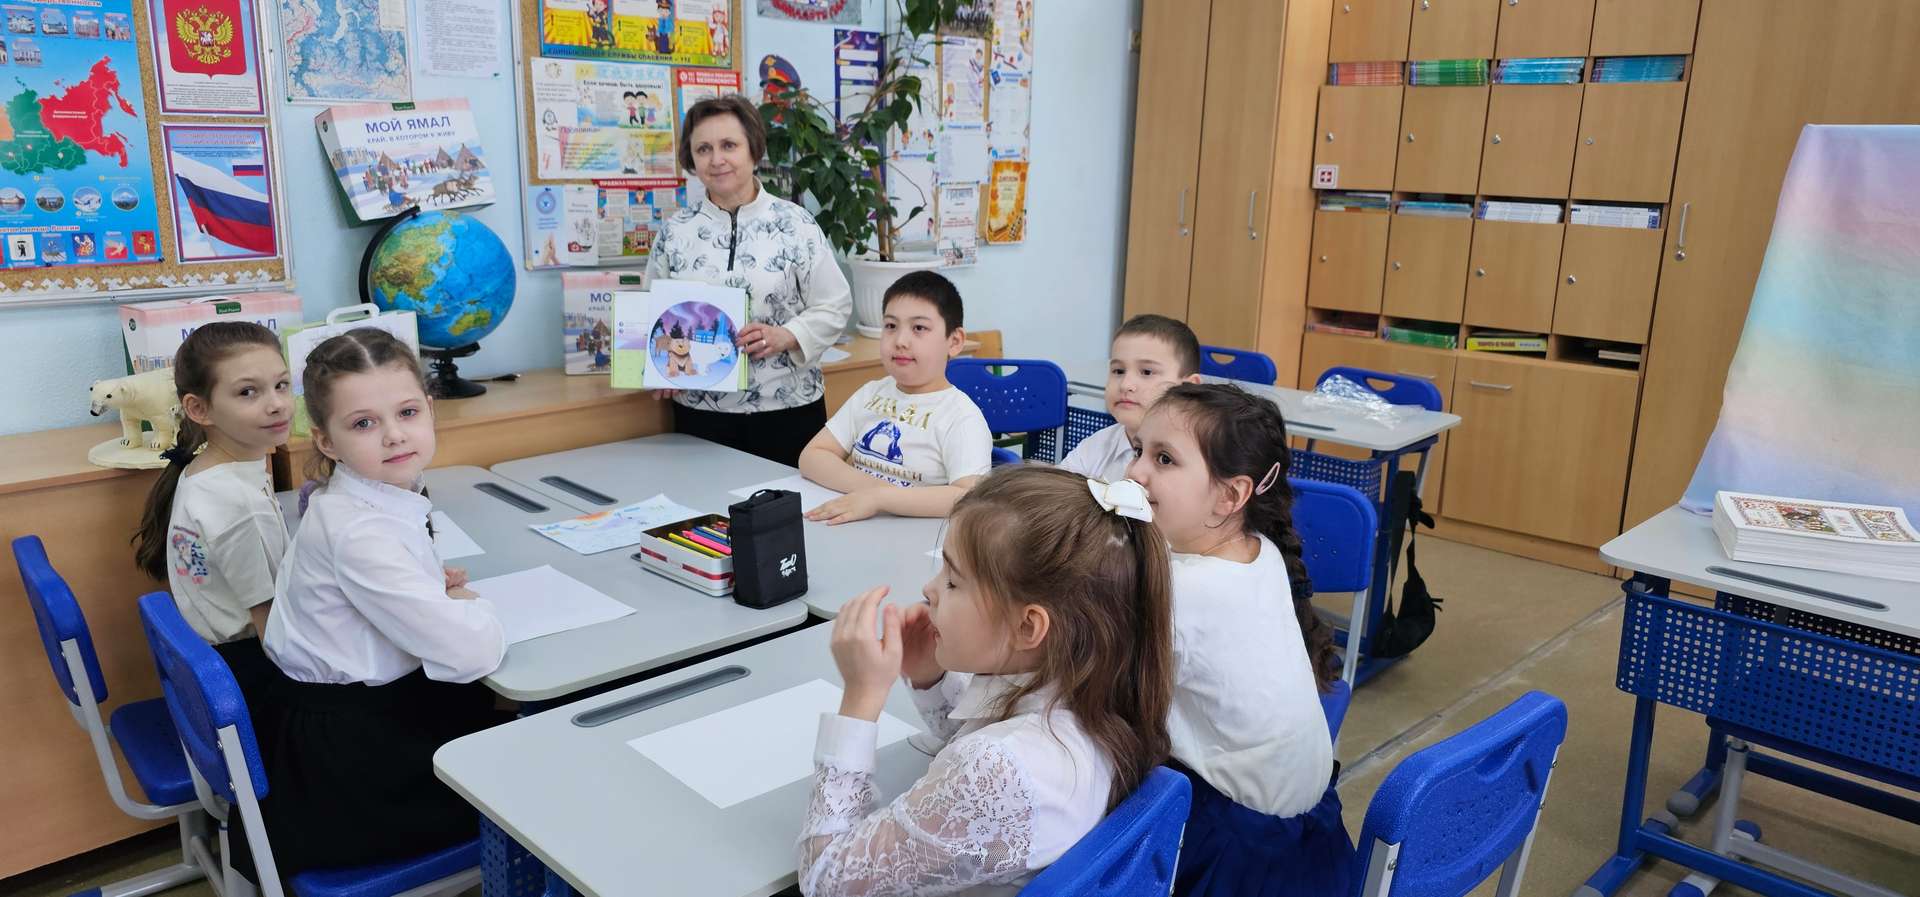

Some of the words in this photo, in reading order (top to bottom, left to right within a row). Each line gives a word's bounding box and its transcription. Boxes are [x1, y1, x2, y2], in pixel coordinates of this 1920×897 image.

[365, 117, 402, 133] МОЙ
[406, 116, 451, 130] ЯМАЛ
[590, 292, 612, 303] МО
